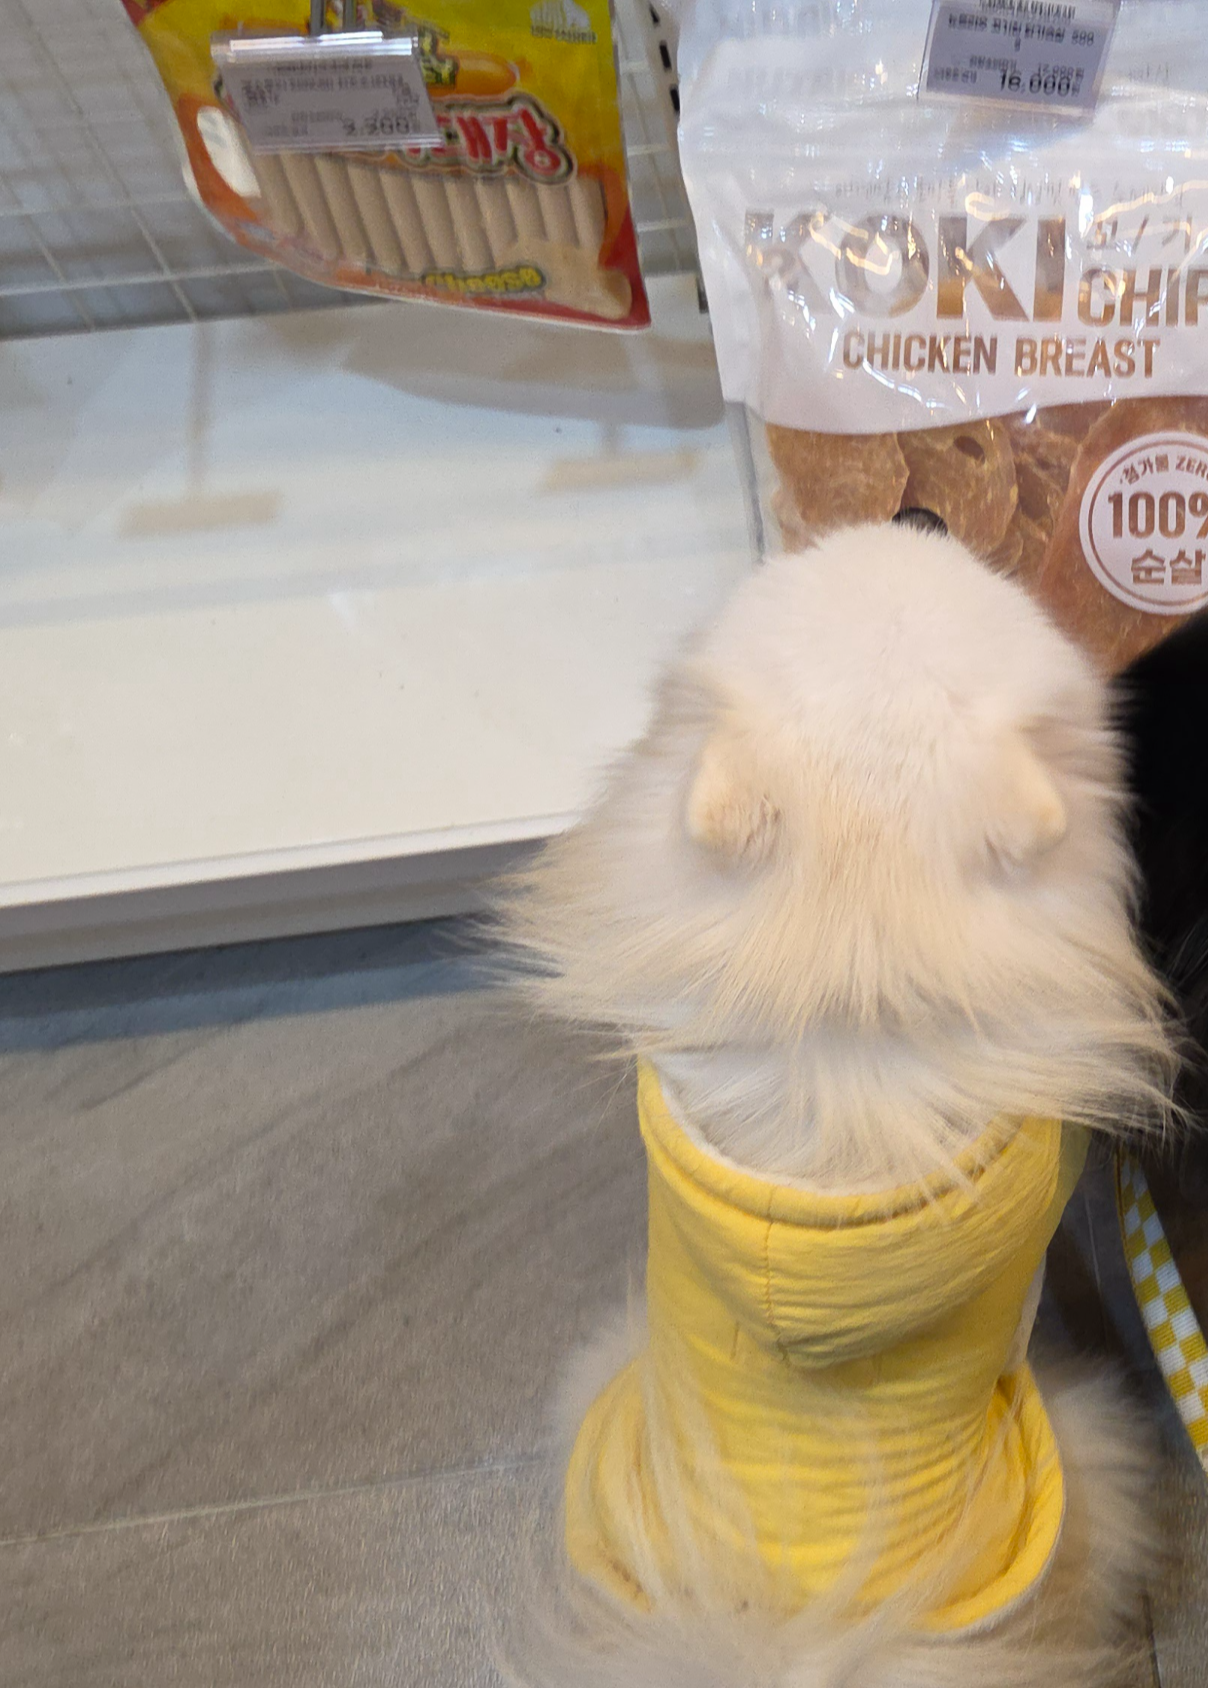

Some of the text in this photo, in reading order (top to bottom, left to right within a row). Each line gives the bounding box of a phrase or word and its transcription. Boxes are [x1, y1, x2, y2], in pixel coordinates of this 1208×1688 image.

[744, 208, 1067, 322] KOKI
[842, 330, 1162, 379] CHICKEN BREAST
[1122, 454, 1170, 486] 첨가물
[1130, 548, 1207, 586] 순살
